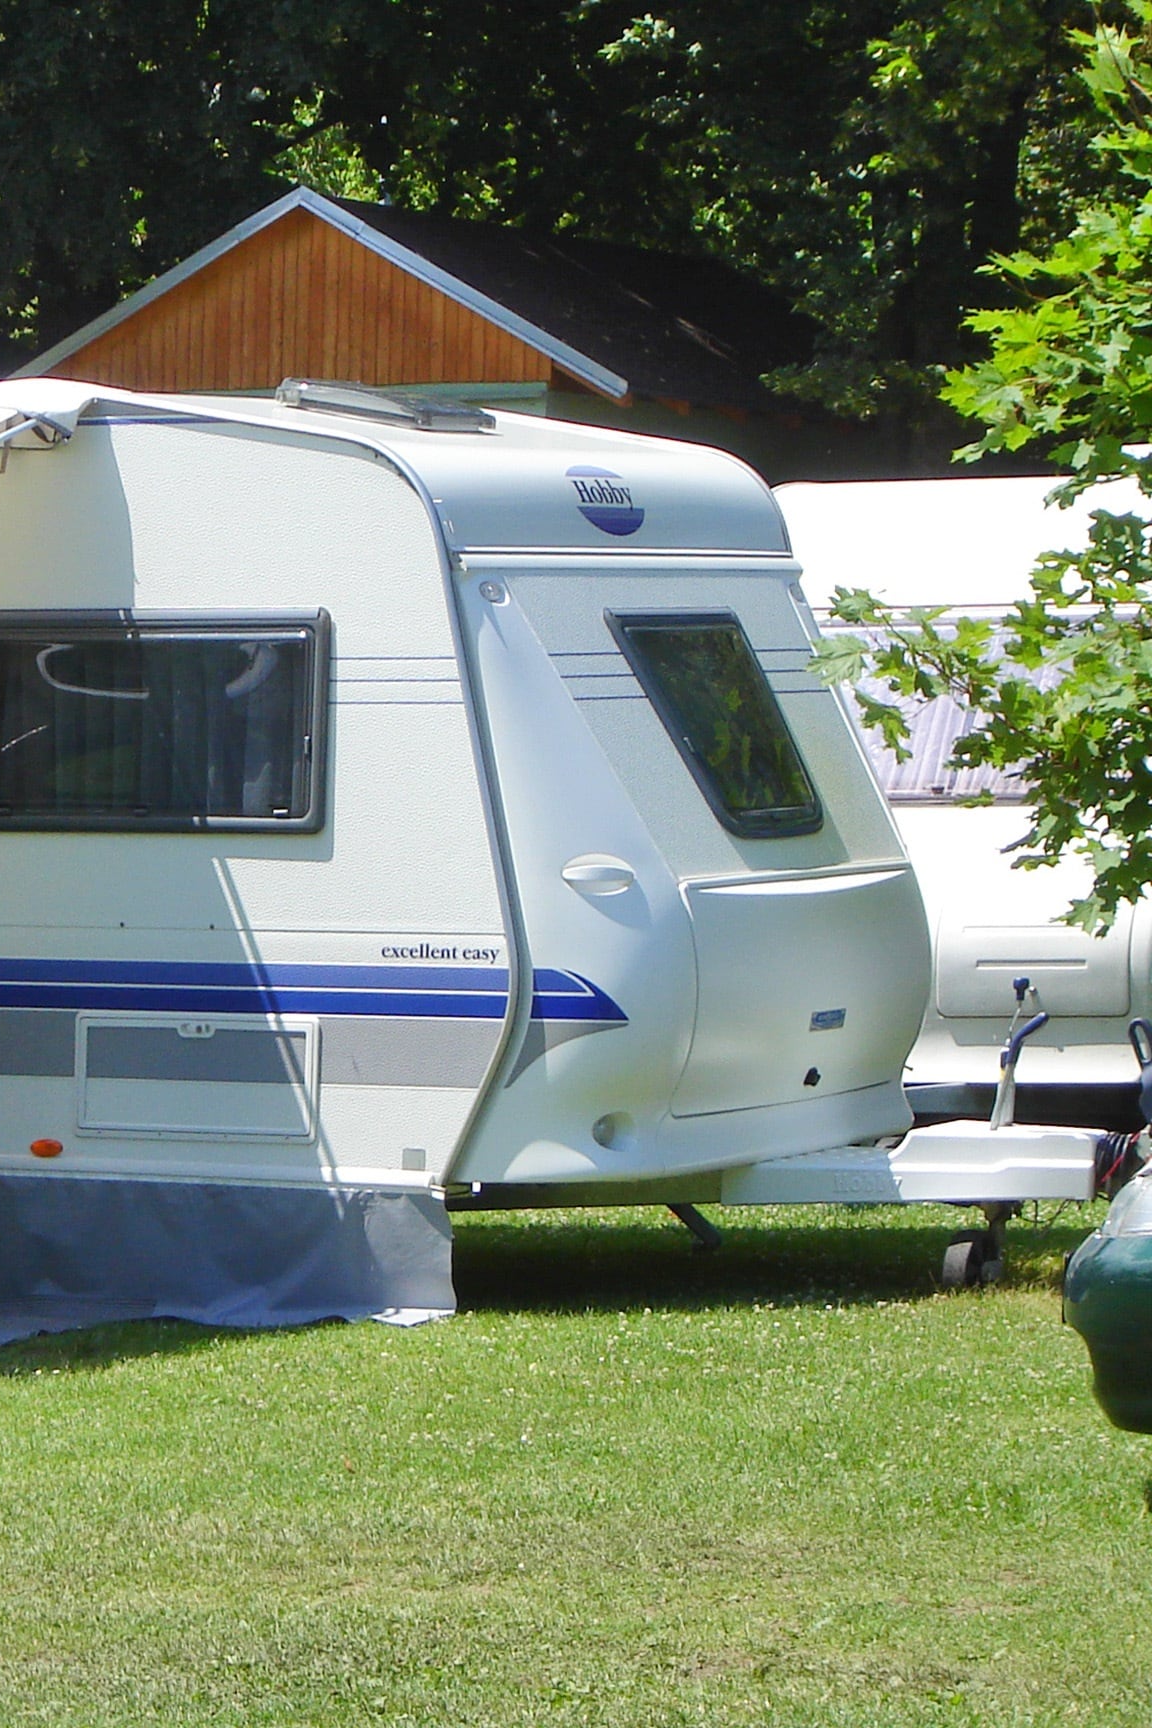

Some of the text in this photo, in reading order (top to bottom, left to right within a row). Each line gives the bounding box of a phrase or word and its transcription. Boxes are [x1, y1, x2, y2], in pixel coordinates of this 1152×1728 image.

[571, 479, 633, 511] Hobby
[381, 943, 500, 964] excellent easy
